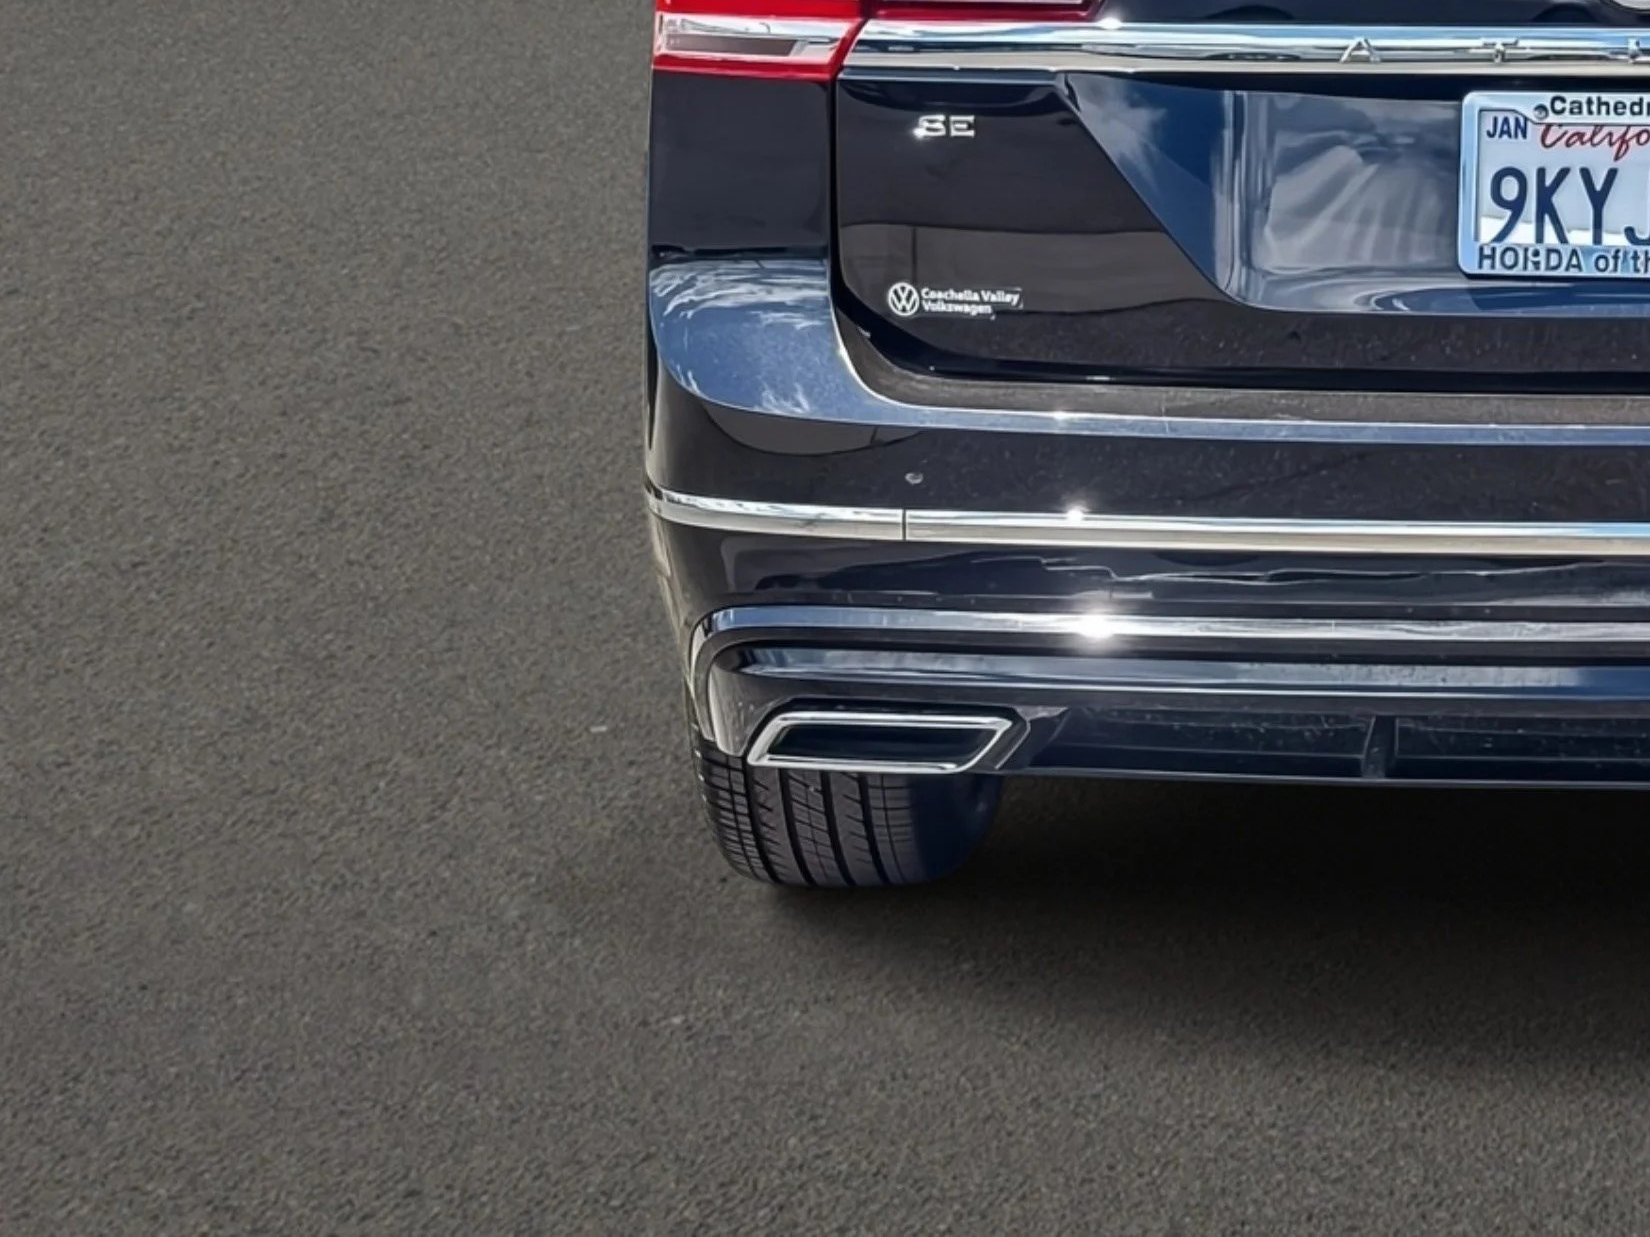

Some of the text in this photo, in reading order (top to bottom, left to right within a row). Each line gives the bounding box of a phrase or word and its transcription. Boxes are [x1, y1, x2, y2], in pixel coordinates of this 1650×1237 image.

[917, 114, 975, 138] SE
[1486, 116, 1528, 139] JAN
[1478, 246, 1583, 273] HONDA
[1594, 248, 1621, 273] of
[921, 287, 1020, 306] Coachella Valley
